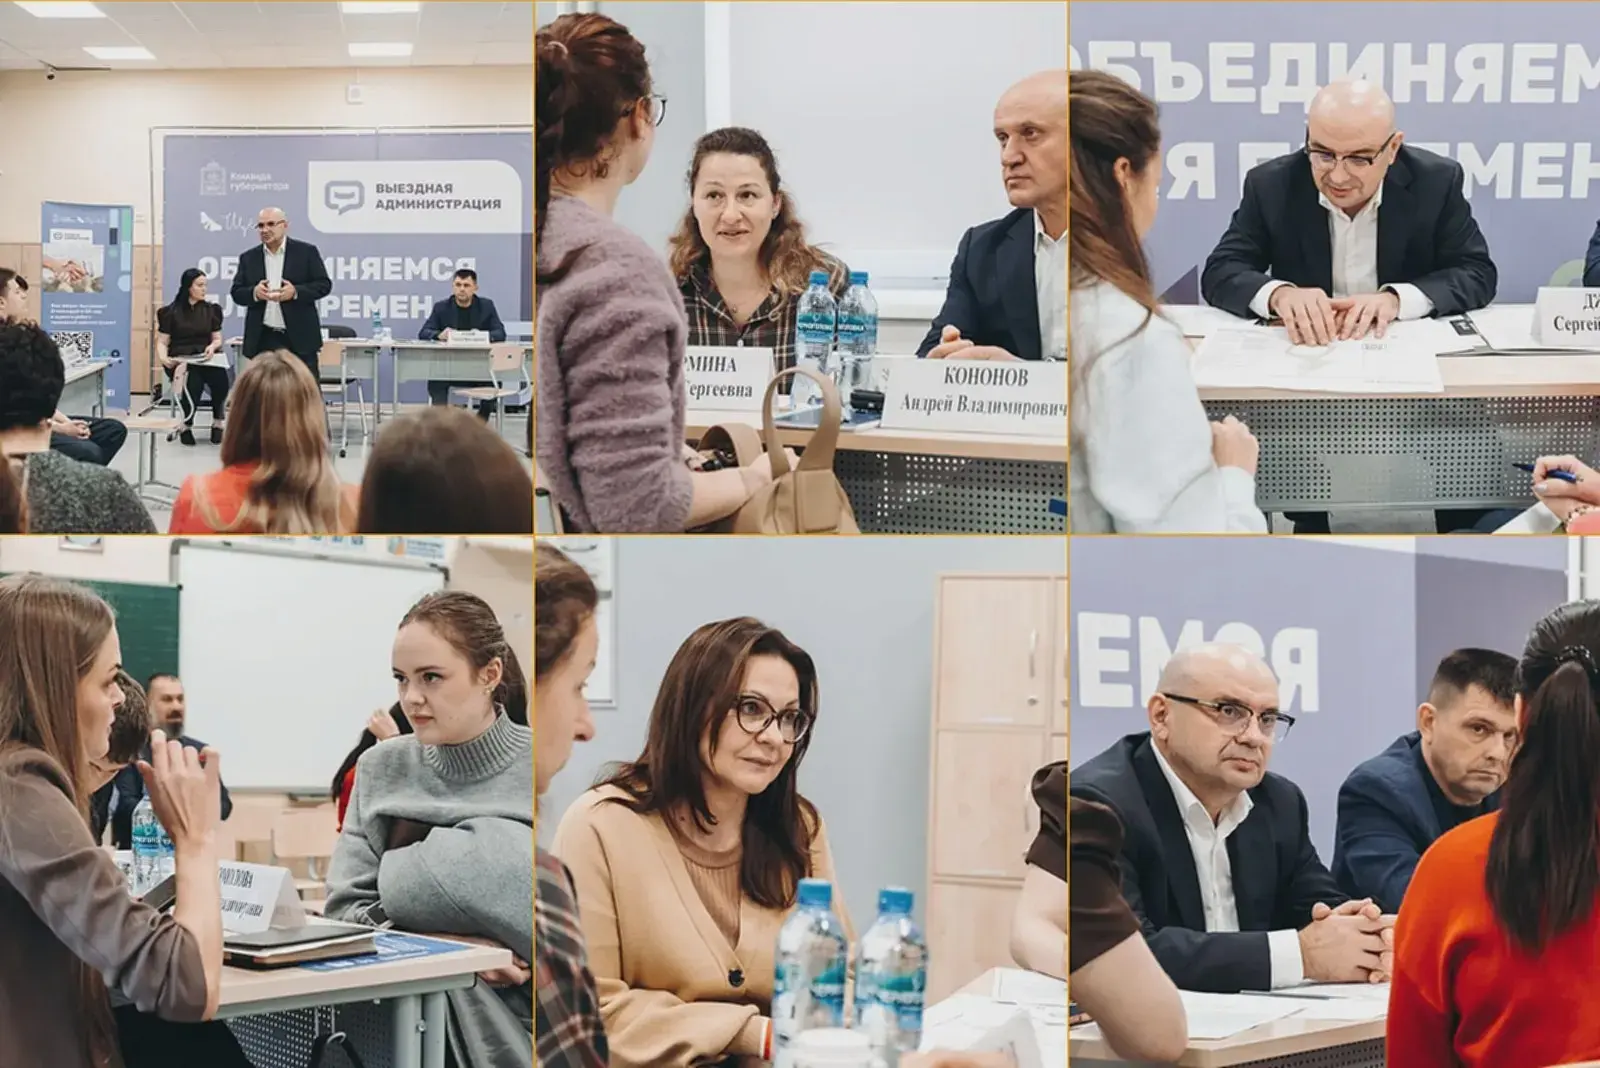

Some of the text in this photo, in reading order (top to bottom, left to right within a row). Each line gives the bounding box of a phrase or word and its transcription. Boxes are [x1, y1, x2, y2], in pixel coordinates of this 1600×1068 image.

[230, 171, 271, 181] Команда
[229, 182, 290, 192] губернатора
[375, 183, 454, 195] ВЫЕЗДНАЯ
[375, 198, 502, 211] АДМИНИСТРАЦИЯ
[199, 256, 476, 281] ОБНЯЕМСЯ
[317, 294, 433, 319] РЕМЕН
[944, 366, 1029, 387] КОНОНОВ
[685, 379, 753, 400] ергеевна
[900, 392, 1068, 420] Андрей Владимирович
